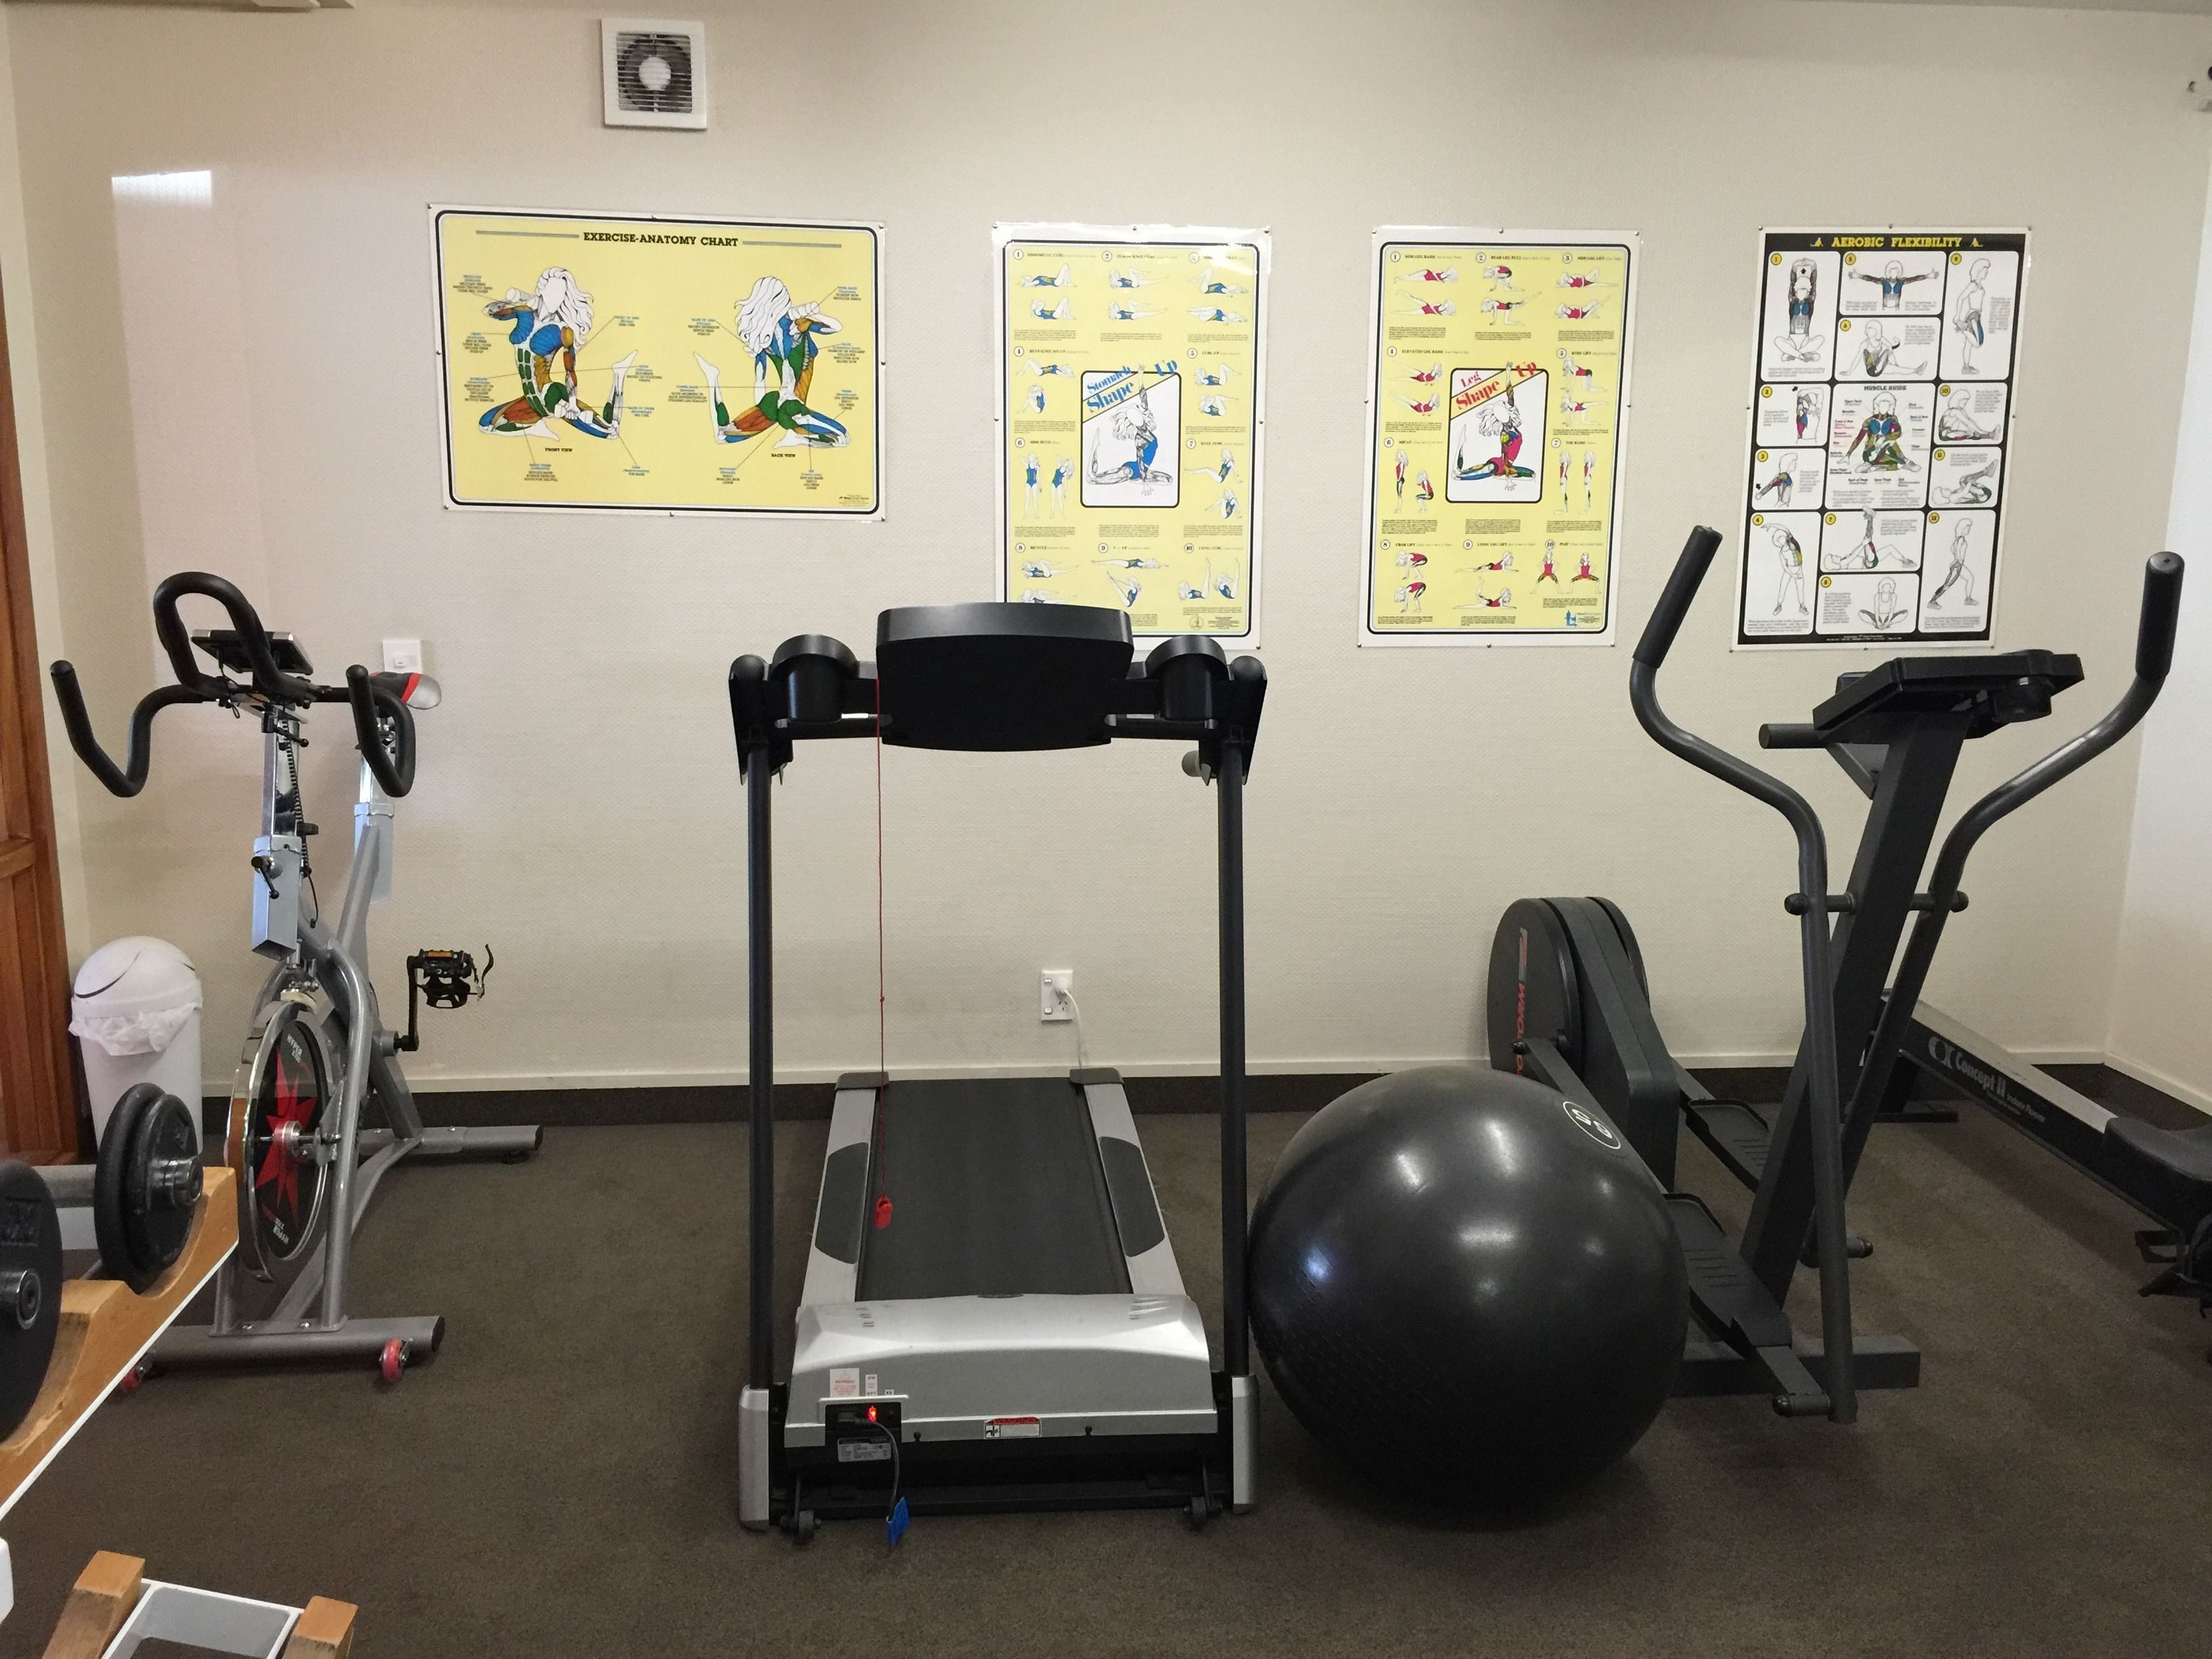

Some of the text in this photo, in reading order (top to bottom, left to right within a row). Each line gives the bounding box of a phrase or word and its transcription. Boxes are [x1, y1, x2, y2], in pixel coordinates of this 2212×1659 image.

[583, 232, 738, 246] EXERCISE-ANATOMY CHART
[1831, 237, 1963, 247] AEROBIC FLEXIBILITY
[1086, 365, 1132, 393] Stomach
[1086, 360, 1178, 413] Shape Up
[1455, 361, 1537, 410] Shape Up
[1460, 371, 1482, 388] Leg
[287, 1033, 303, 1058] HYPER
[1955, 1051, 1996, 1091] Concept
[1996, 1077, 2007, 1099] II
[2007, 1093, 2026, 1110] Indoor
